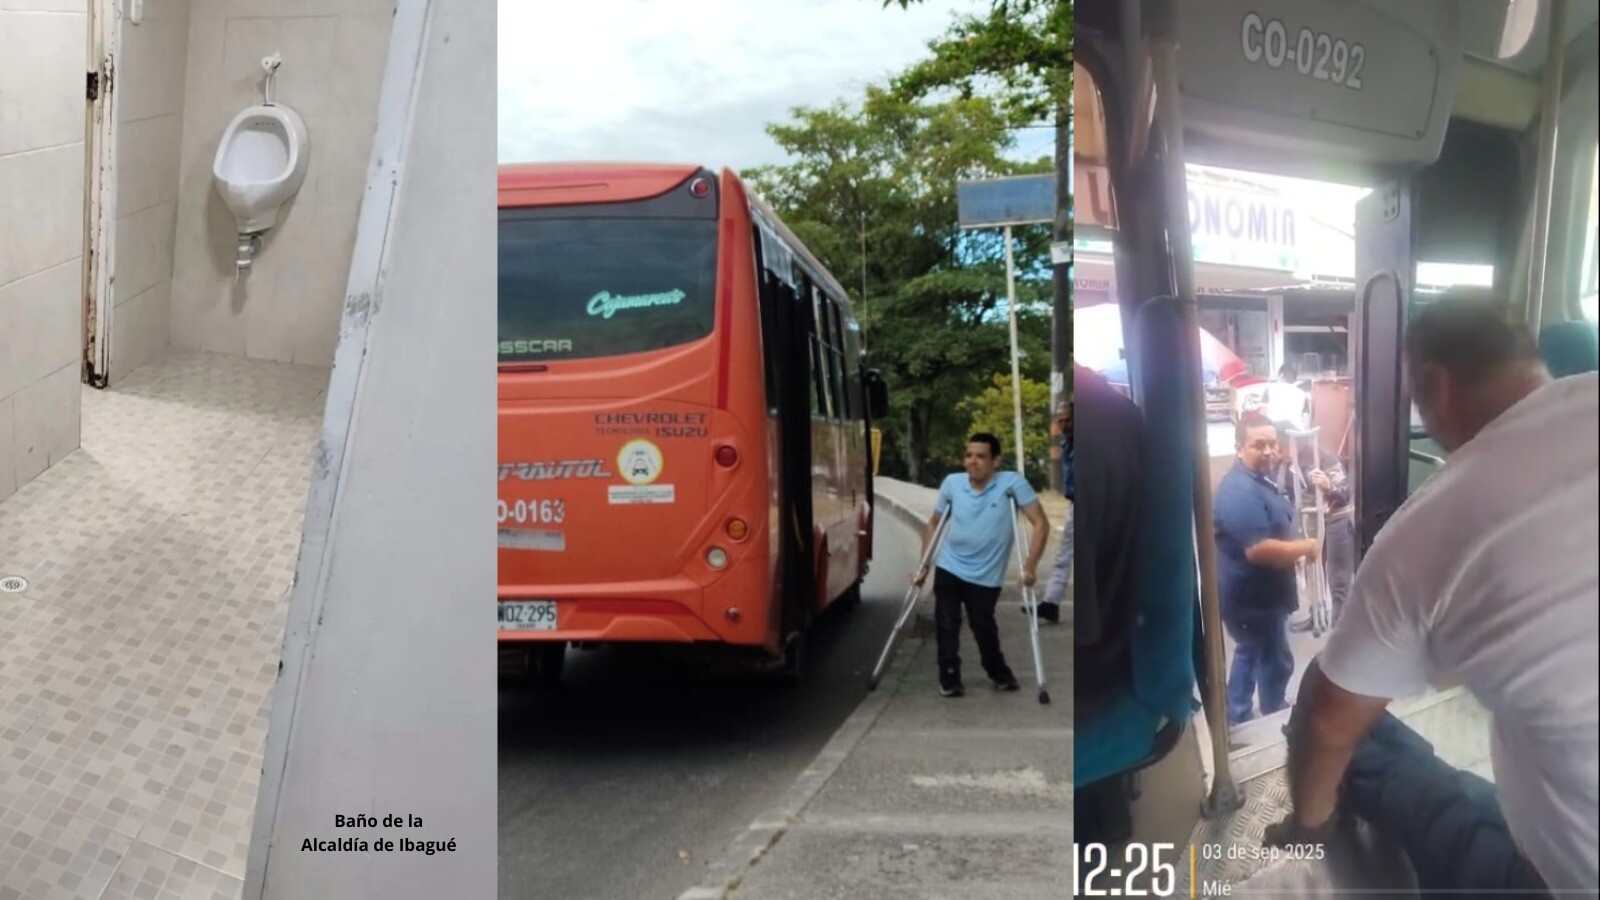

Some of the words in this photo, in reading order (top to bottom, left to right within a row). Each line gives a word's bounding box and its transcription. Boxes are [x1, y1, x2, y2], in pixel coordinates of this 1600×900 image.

[1241, 12, 1366, 90] CO-0292
[498, 339, 572, 353] SSCAR
[594, 412, 708, 427] CHEVROLET
[655, 426, 709, 438] ISUZU
[498, 499, 566, 523] O-0163
